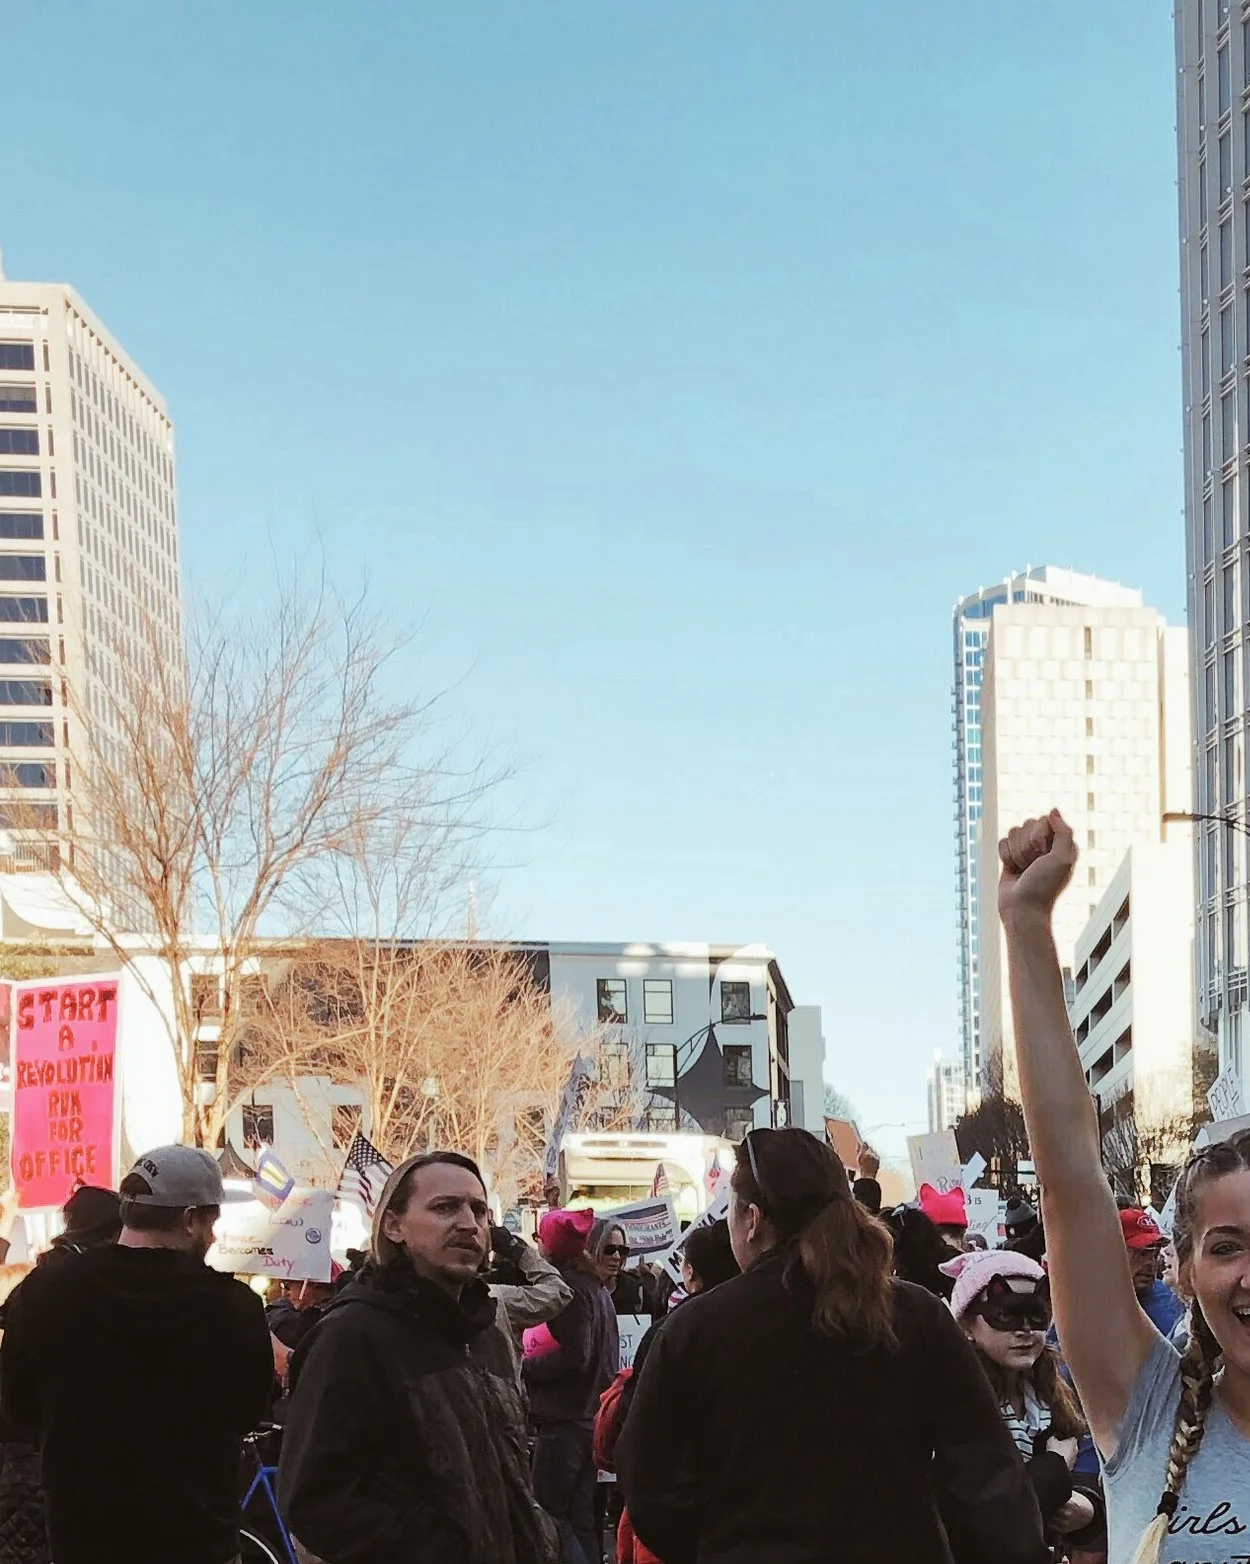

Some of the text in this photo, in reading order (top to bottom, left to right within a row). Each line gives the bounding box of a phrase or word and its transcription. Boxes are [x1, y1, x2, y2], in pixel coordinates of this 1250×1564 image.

[19, 988, 117, 1031] START
[58, 1024, 74, 1051] A
[48, 1090, 82, 1118] RUN
[49, 1117, 84, 1143] FOR
[19, 1144, 98, 1182] OFFICE
[262, 1256, 295, 1276] Duty
[1164, 1501, 1247, 1535] irls
